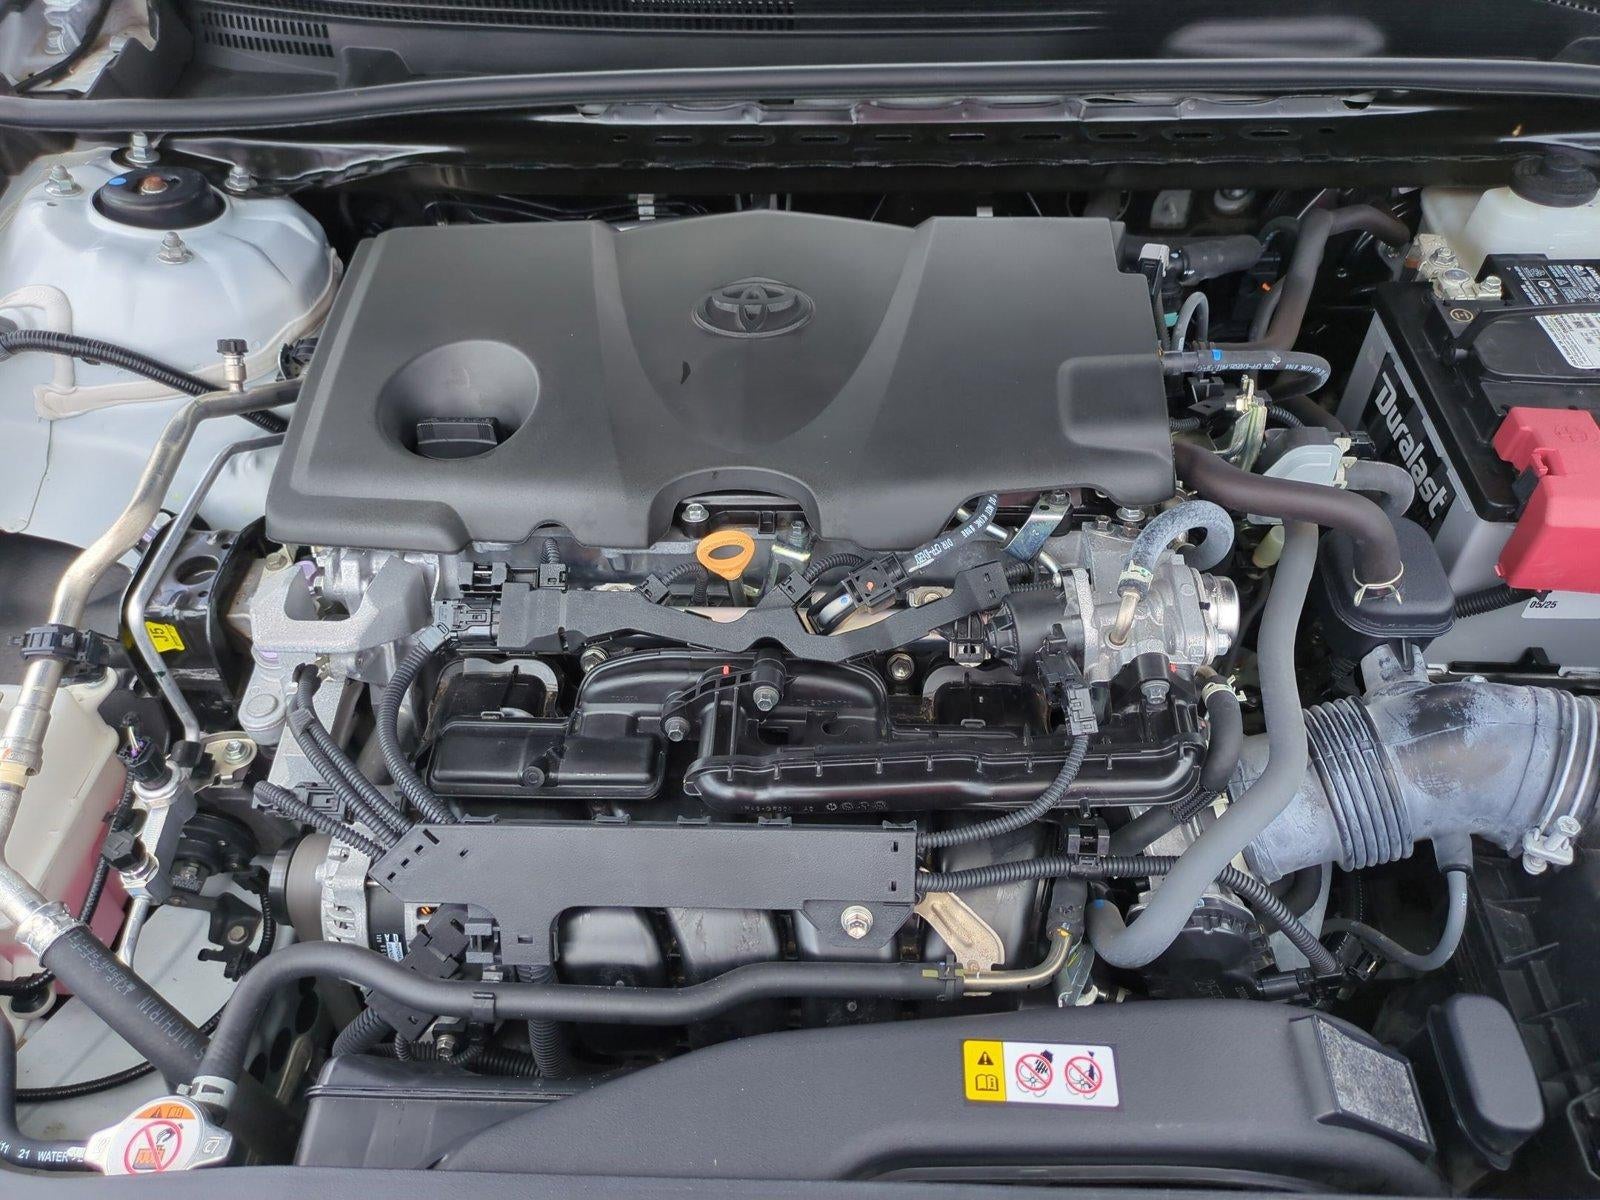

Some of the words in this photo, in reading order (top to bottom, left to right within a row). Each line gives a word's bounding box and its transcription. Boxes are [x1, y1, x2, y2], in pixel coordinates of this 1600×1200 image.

[1375, 372, 1448, 518] Duralast
[1529, 601, 1557, 609] 05/25
[17, 1148, 30, 1159] 21
[37, 1150, 68, 1162] WATER
